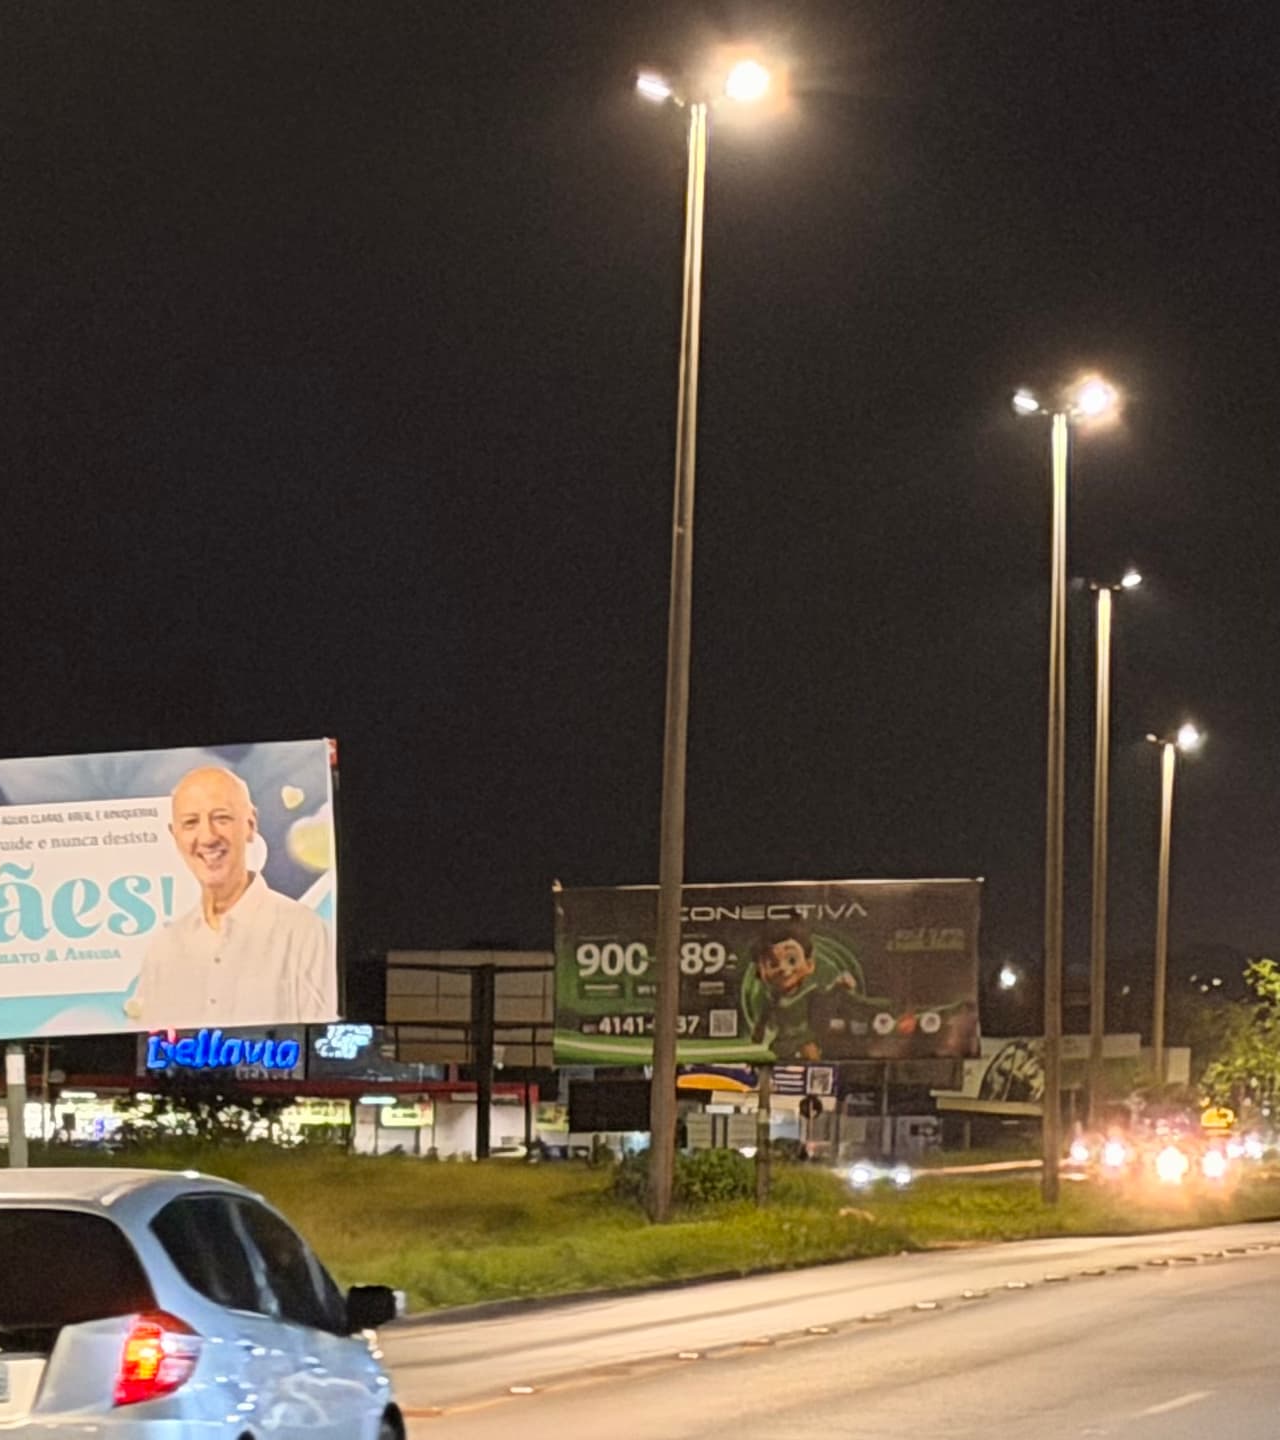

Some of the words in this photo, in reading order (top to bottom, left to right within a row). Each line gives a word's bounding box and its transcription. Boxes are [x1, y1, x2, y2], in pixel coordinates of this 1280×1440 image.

[38, 838, 47, 849] e
[51, 833, 99, 848] nunca
[102, 829, 159, 846] desista
[576, 943, 649, 977] 900
